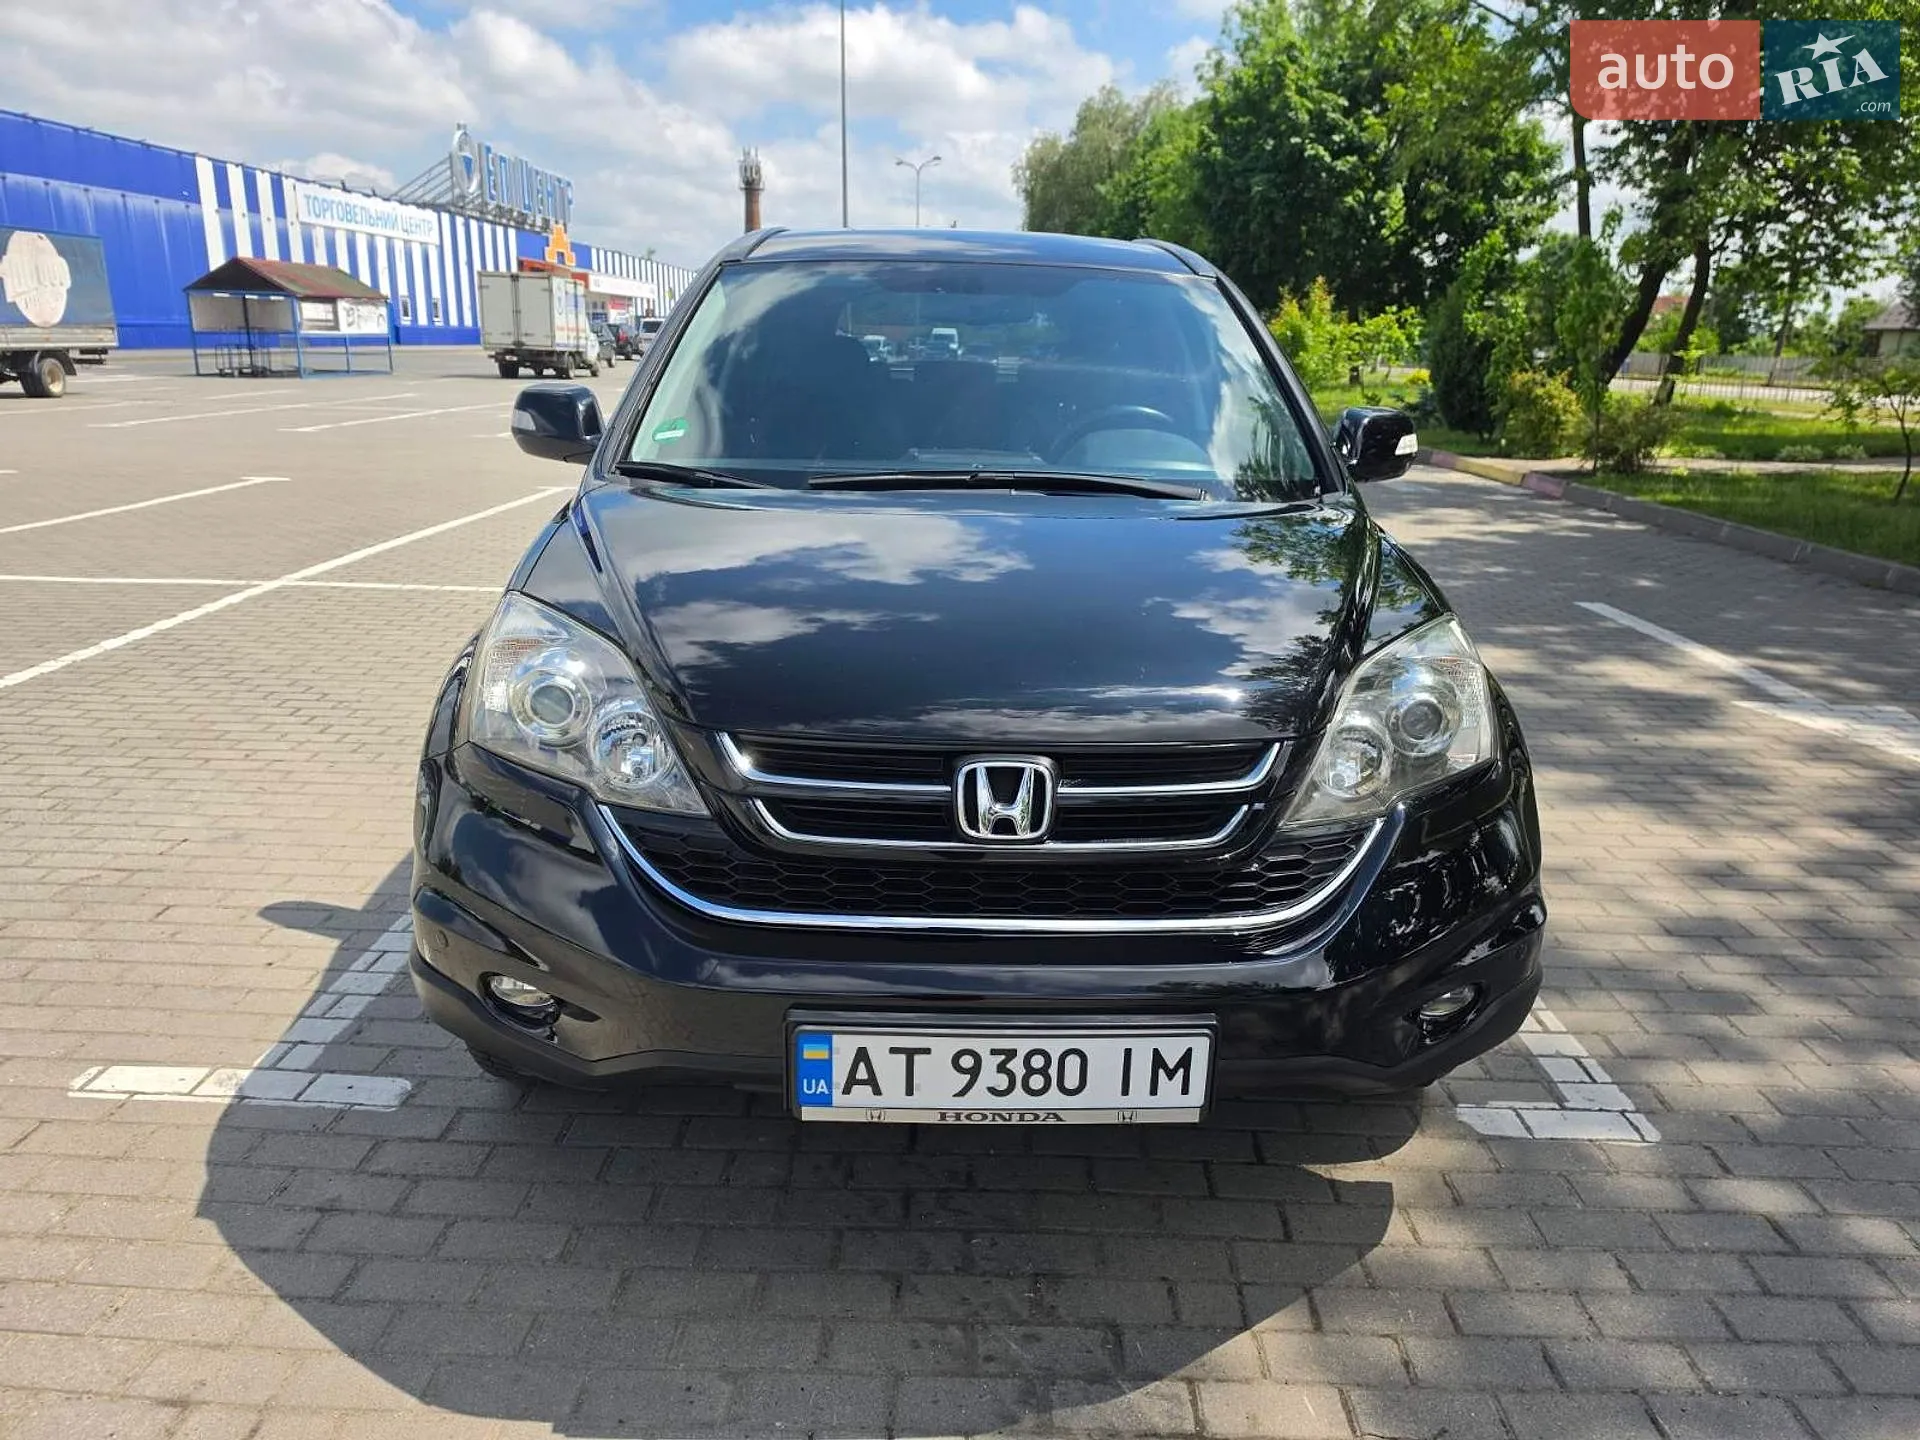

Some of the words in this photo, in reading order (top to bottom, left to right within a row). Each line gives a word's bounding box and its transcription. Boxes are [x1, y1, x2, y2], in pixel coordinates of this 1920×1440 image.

[303, 194, 399, 231] ТОРГОВЕЛЬНИЙ
[401, 214, 433, 237] ЦЕНТР
[803, 1079, 829, 1094] UA
[842, 1046, 932, 1096] AT
[951, 1048, 1088, 1098] 9380
[1121, 1047, 1192, 1096] IM
[937, 1111, 1066, 1123] HONDA
